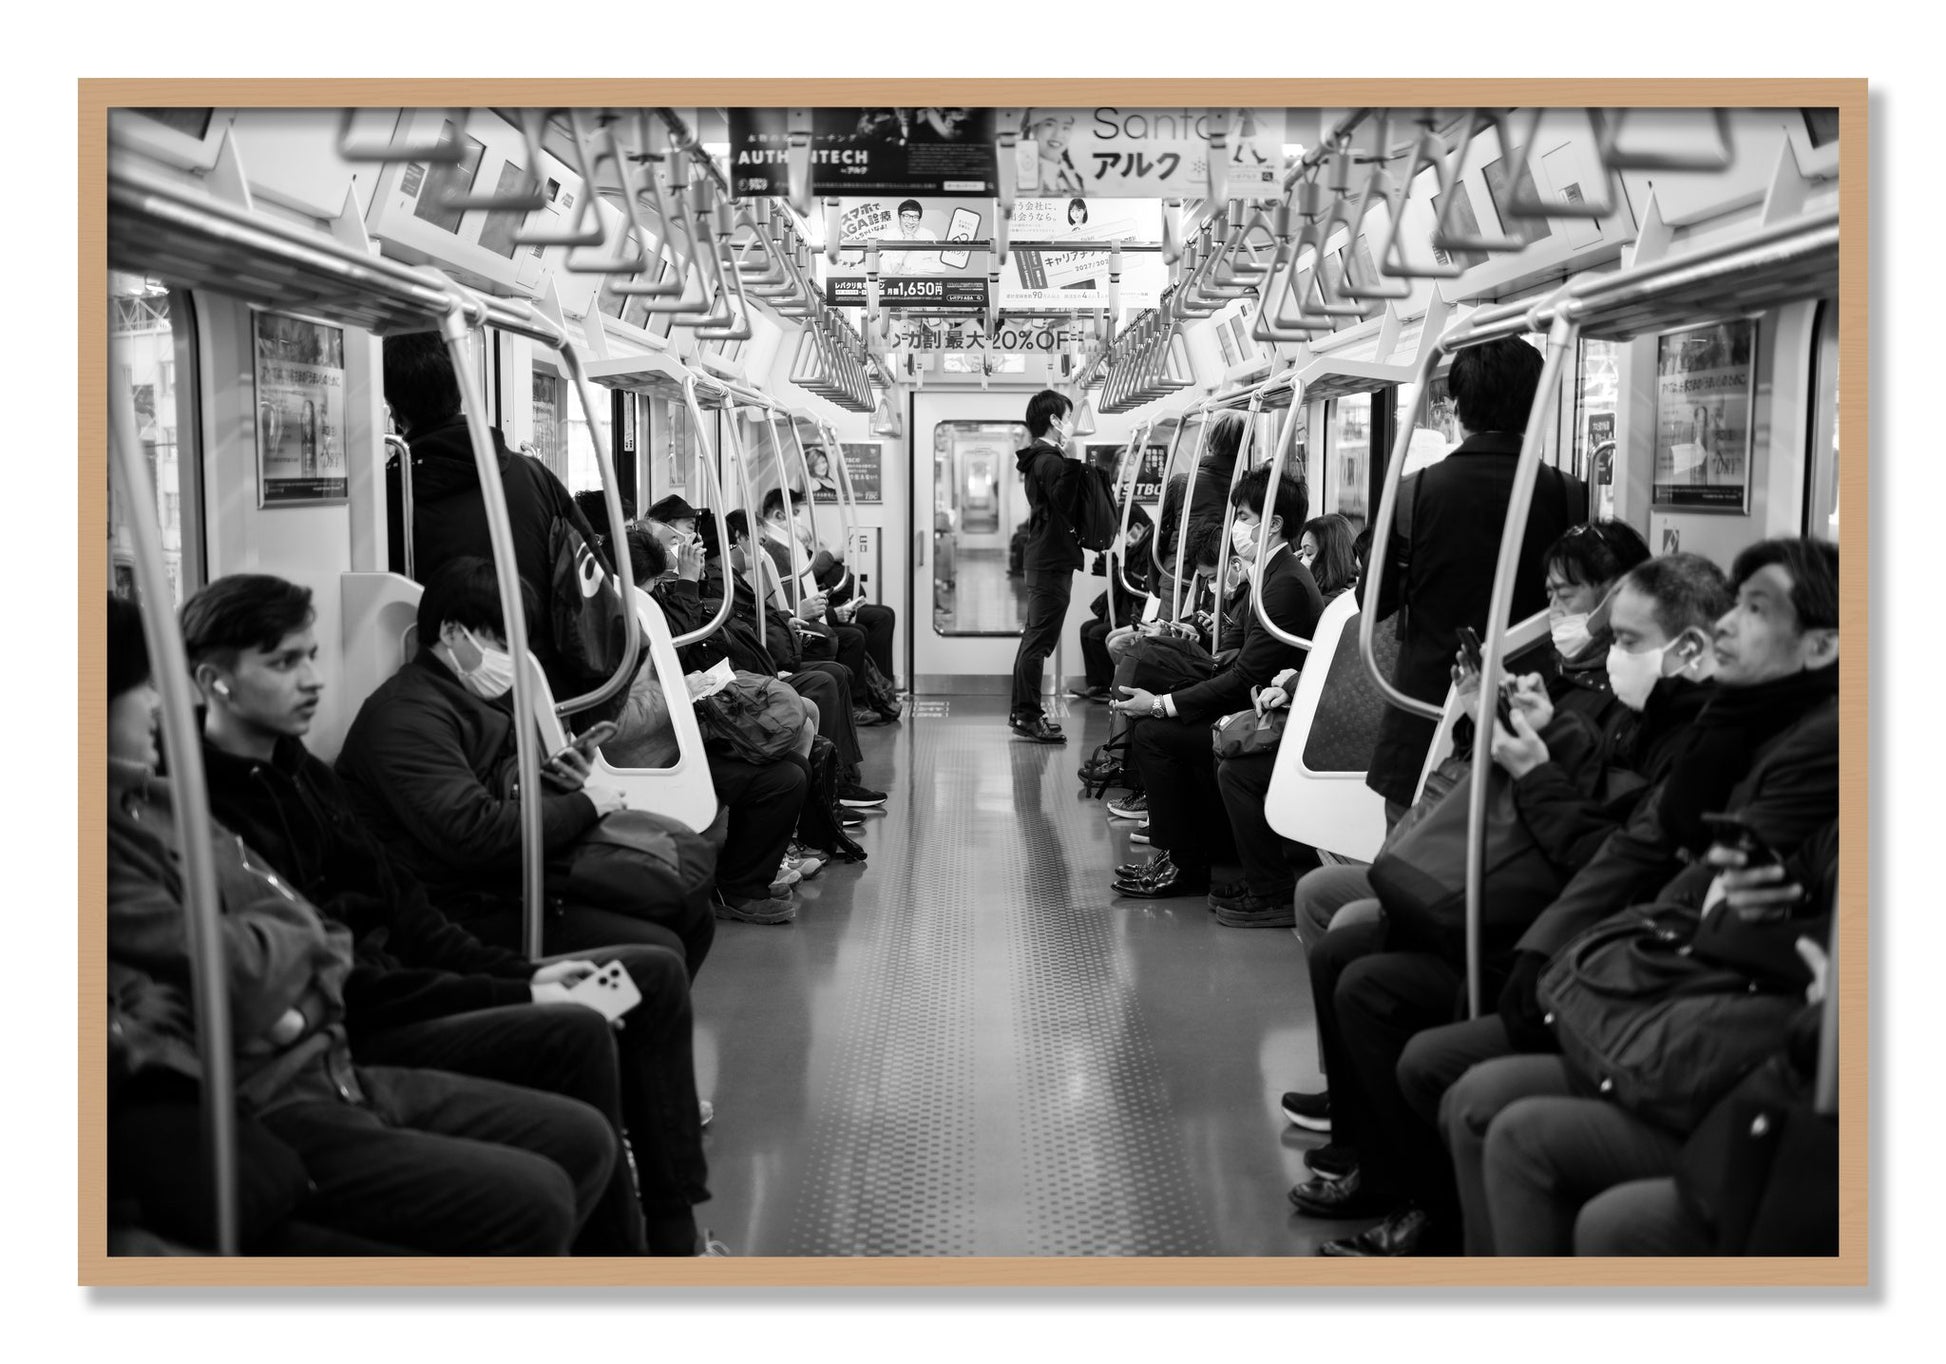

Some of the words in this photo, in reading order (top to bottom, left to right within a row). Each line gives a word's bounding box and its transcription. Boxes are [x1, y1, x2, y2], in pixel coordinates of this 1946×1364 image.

[738, 150, 868, 164] AUTHTECH
[1093, 152, 1181, 180] アルク
[1136, 483, 1163, 495] TBC
